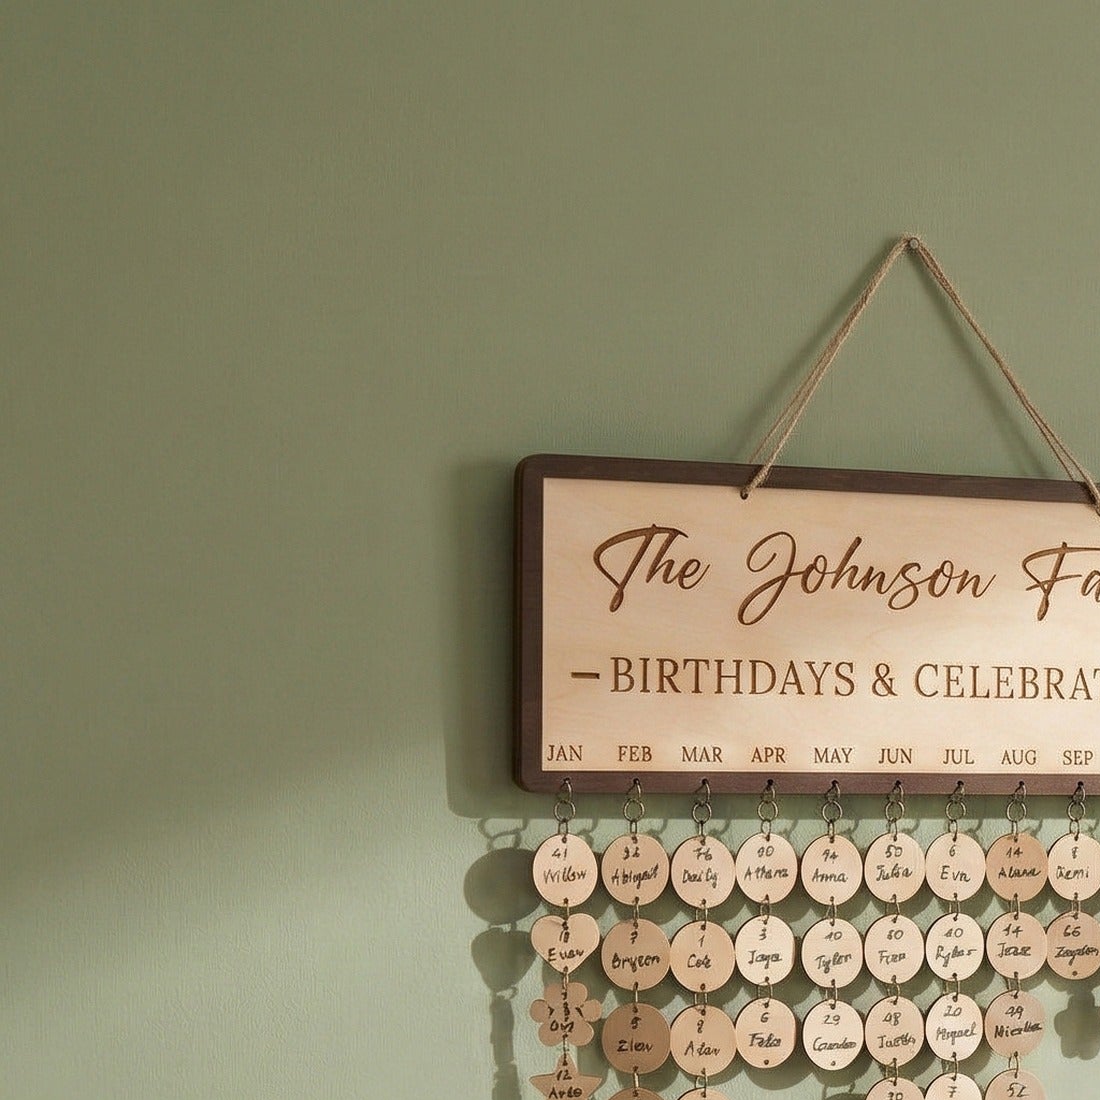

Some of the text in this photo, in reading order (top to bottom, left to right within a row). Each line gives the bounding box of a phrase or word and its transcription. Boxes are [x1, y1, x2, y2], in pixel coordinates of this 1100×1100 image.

[593, 524, 710, 612] The
[737, 531, 996, 625] Johnson
[610, 657, 855, 696] BIRTHDAYS
[871, 663, 898, 696] &
[547, 745, 583, 762] JAN
[617, 745, 652, 762] FEB
[681, 746, 723, 763] MAR
[751, 747, 787, 763] APR
[813, 747, 853, 764] MAY
[878, 748, 913, 764] JUN
[943, 749, 975, 765] JUL
[1001, 749, 1037, 765] AUG
[1062, 750, 1094, 766] SEP
